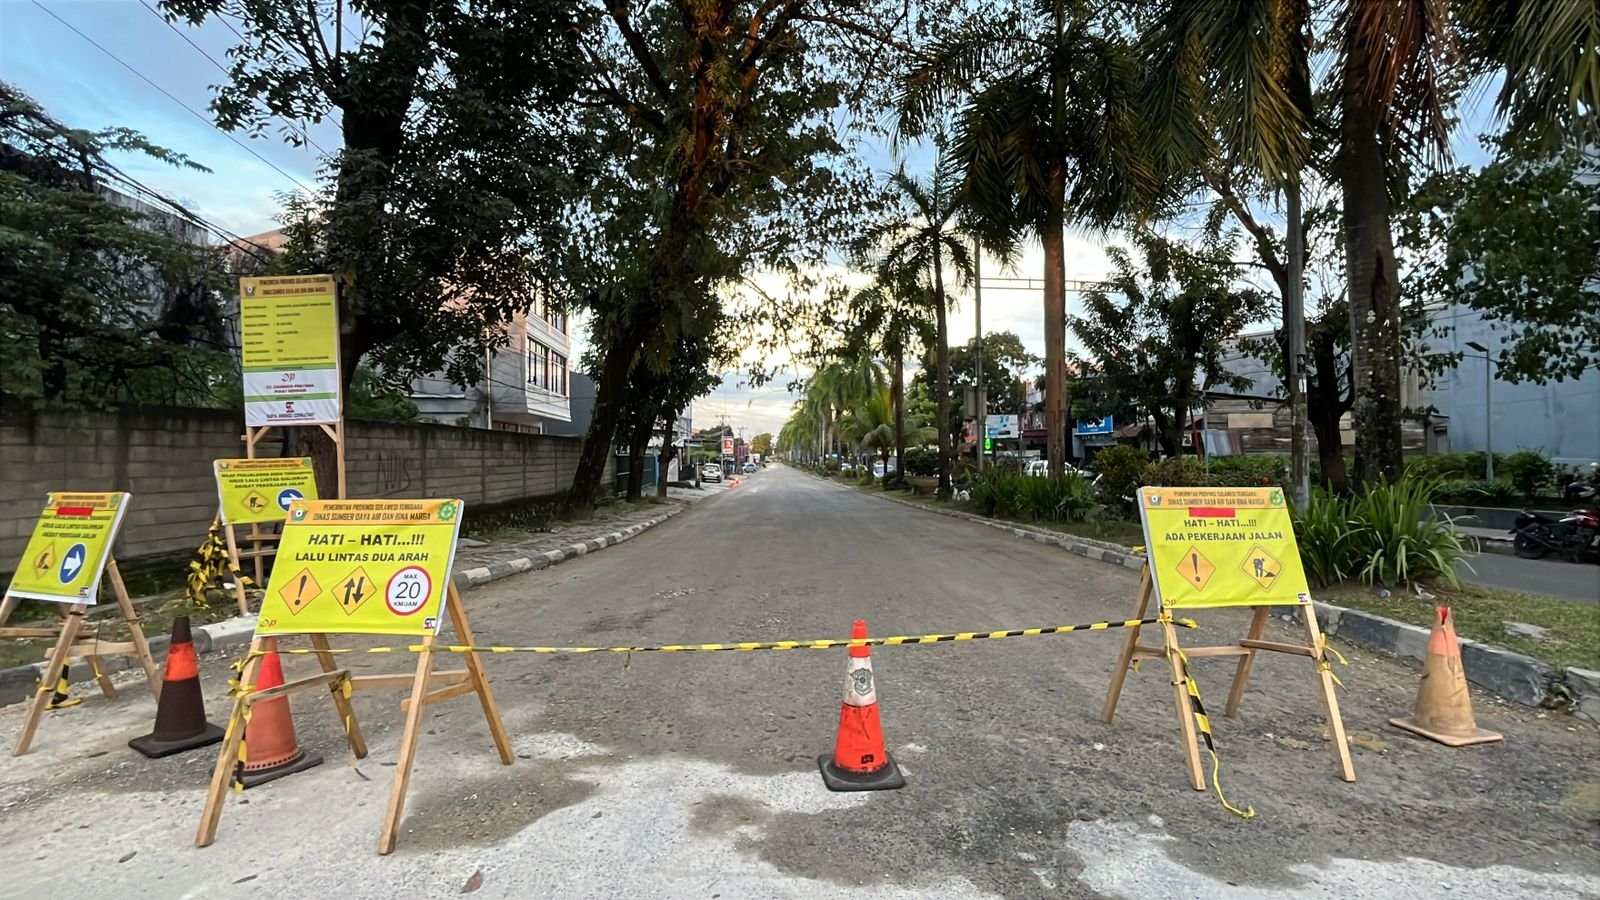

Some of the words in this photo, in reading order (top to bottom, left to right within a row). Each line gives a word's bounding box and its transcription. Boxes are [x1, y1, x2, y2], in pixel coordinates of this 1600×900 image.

[308, 534, 345, 545] HATI
[1249, 532, 1282, 540] JALAN
[295, 552, 325, 561] LALU
[328, 553, 369, 561] LINTAS
[372, 553, 395, 561] DUA
[398, 552, 429, 561] ARAH
[395, 581, 421, 599] 20
